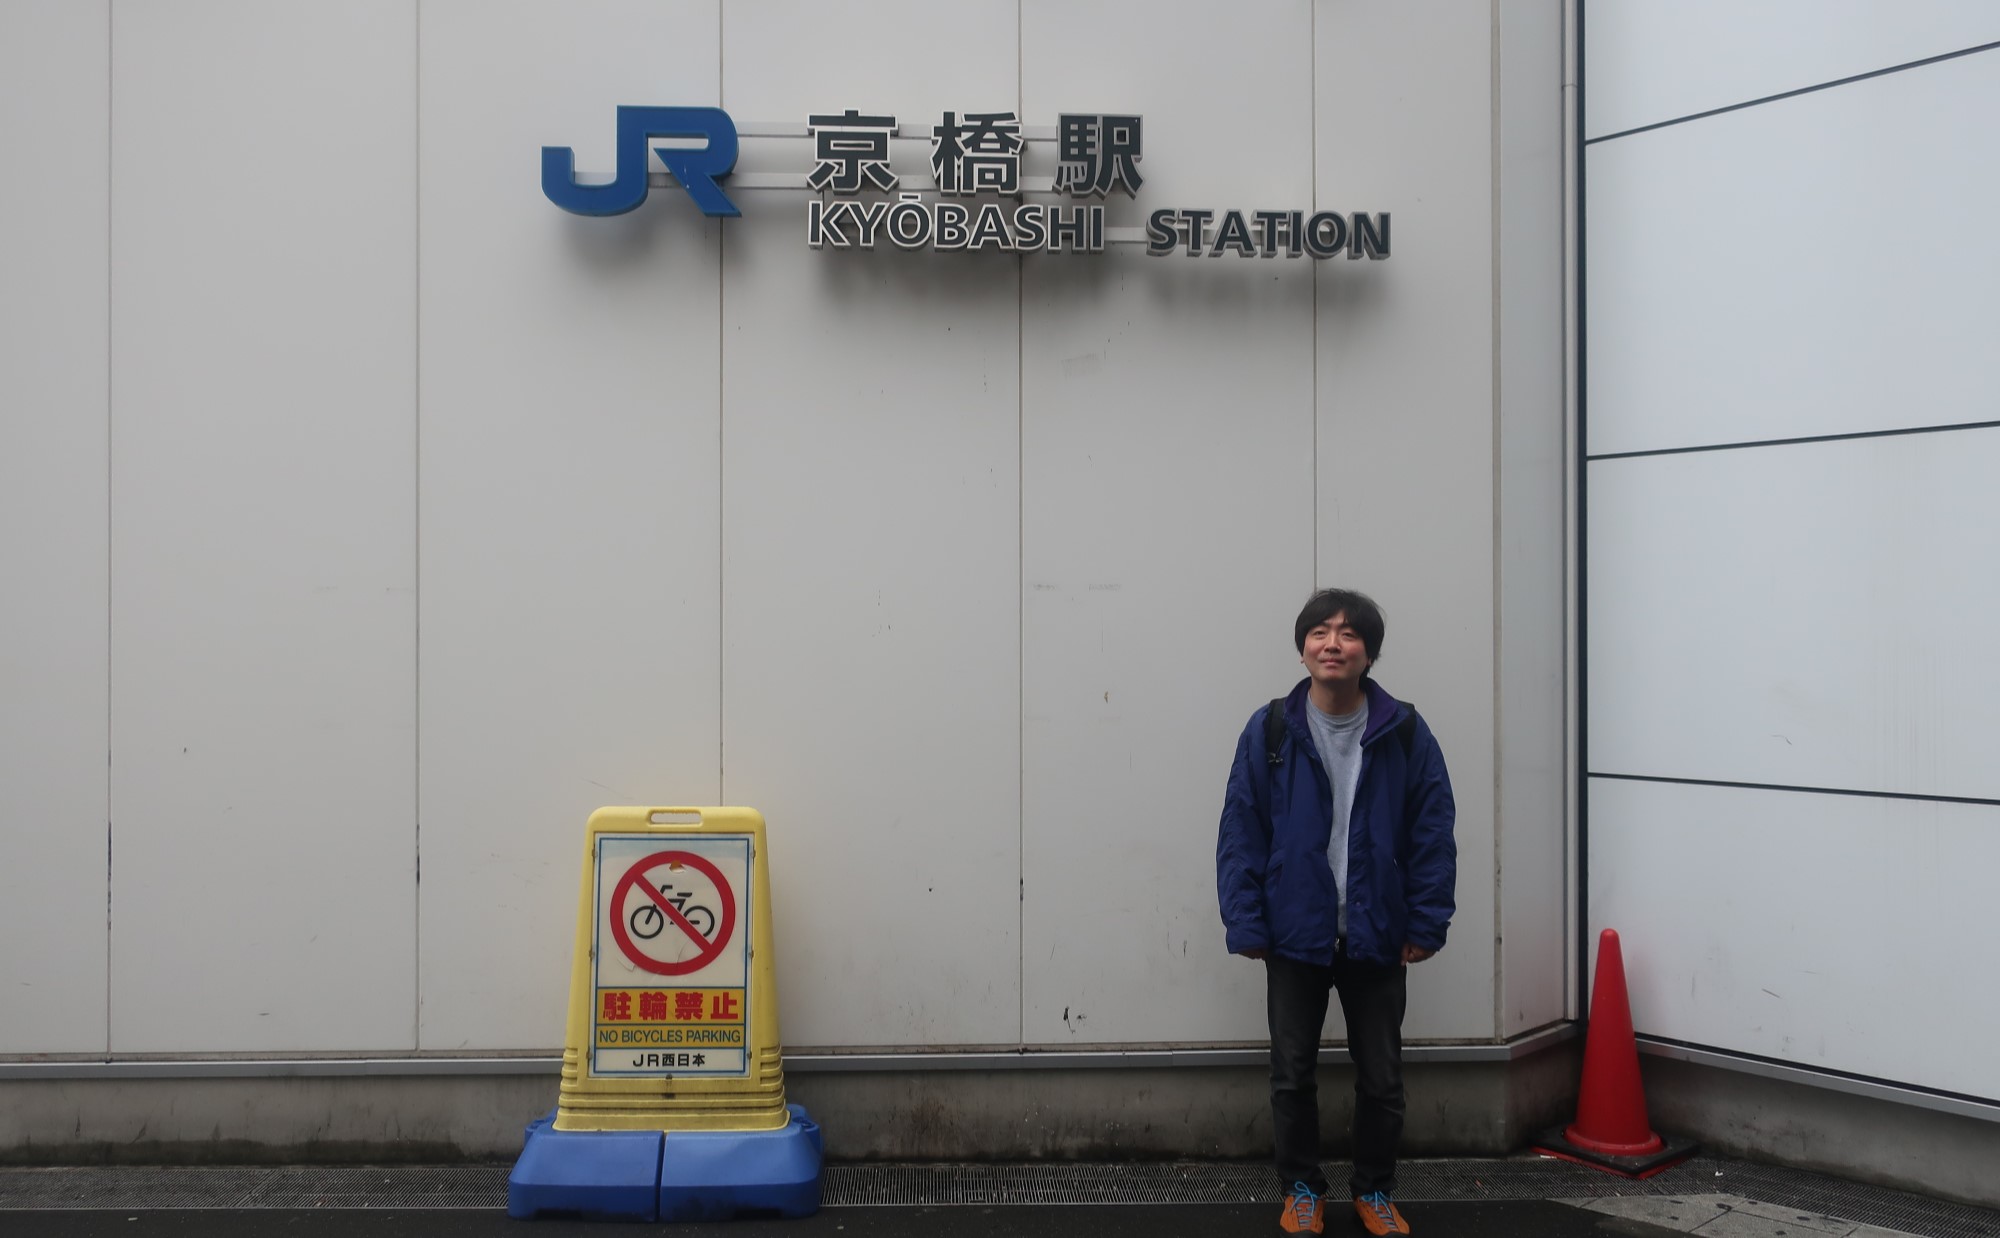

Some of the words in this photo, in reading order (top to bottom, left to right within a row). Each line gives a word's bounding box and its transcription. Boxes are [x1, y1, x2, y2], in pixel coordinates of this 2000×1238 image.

[541, 105, 741, 218] JR
[807, 108, 1144, 198] 京橋駅
[808, 193, 1105, 254] KYŌBASHI
[1147, 208, 1391, 261] STATION
[603, 991, 738, 1021] 駐輪禁止
[600, 1030, 618, 1043] NO
[621, 1029, 683, 1043] BICYCLES
[686, 1029, 741, 1043] PARKING
[632, 1053, 705, 1067] JR西日本
